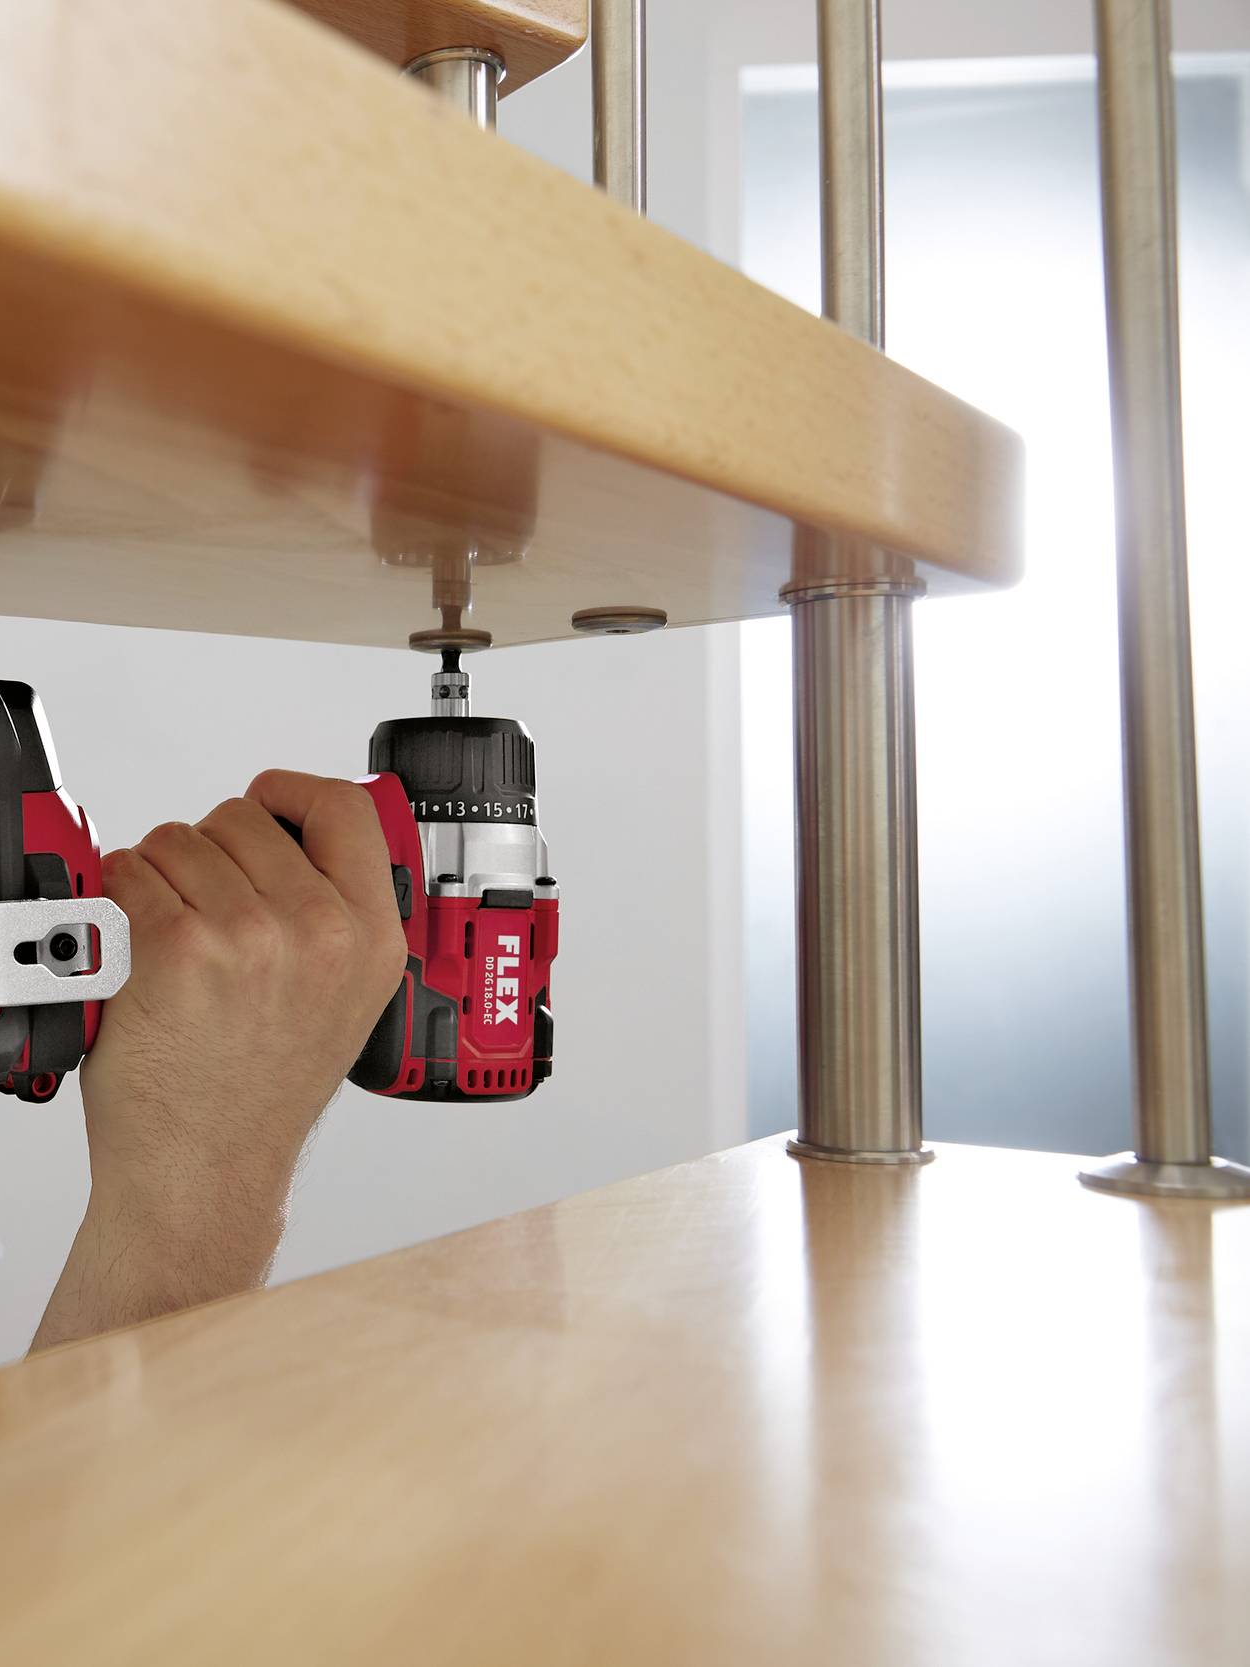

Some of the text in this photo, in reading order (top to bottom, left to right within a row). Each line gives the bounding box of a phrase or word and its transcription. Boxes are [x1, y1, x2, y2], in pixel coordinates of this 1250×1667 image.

[445, 801, 466, 817] 13
[483, 802, 503, 818] 15
[515, 803, 528, 819] 17
[483, 956, 495, 1025] DD 2G 18.0-EC
[495, 935, 520, 1025] FLEX
